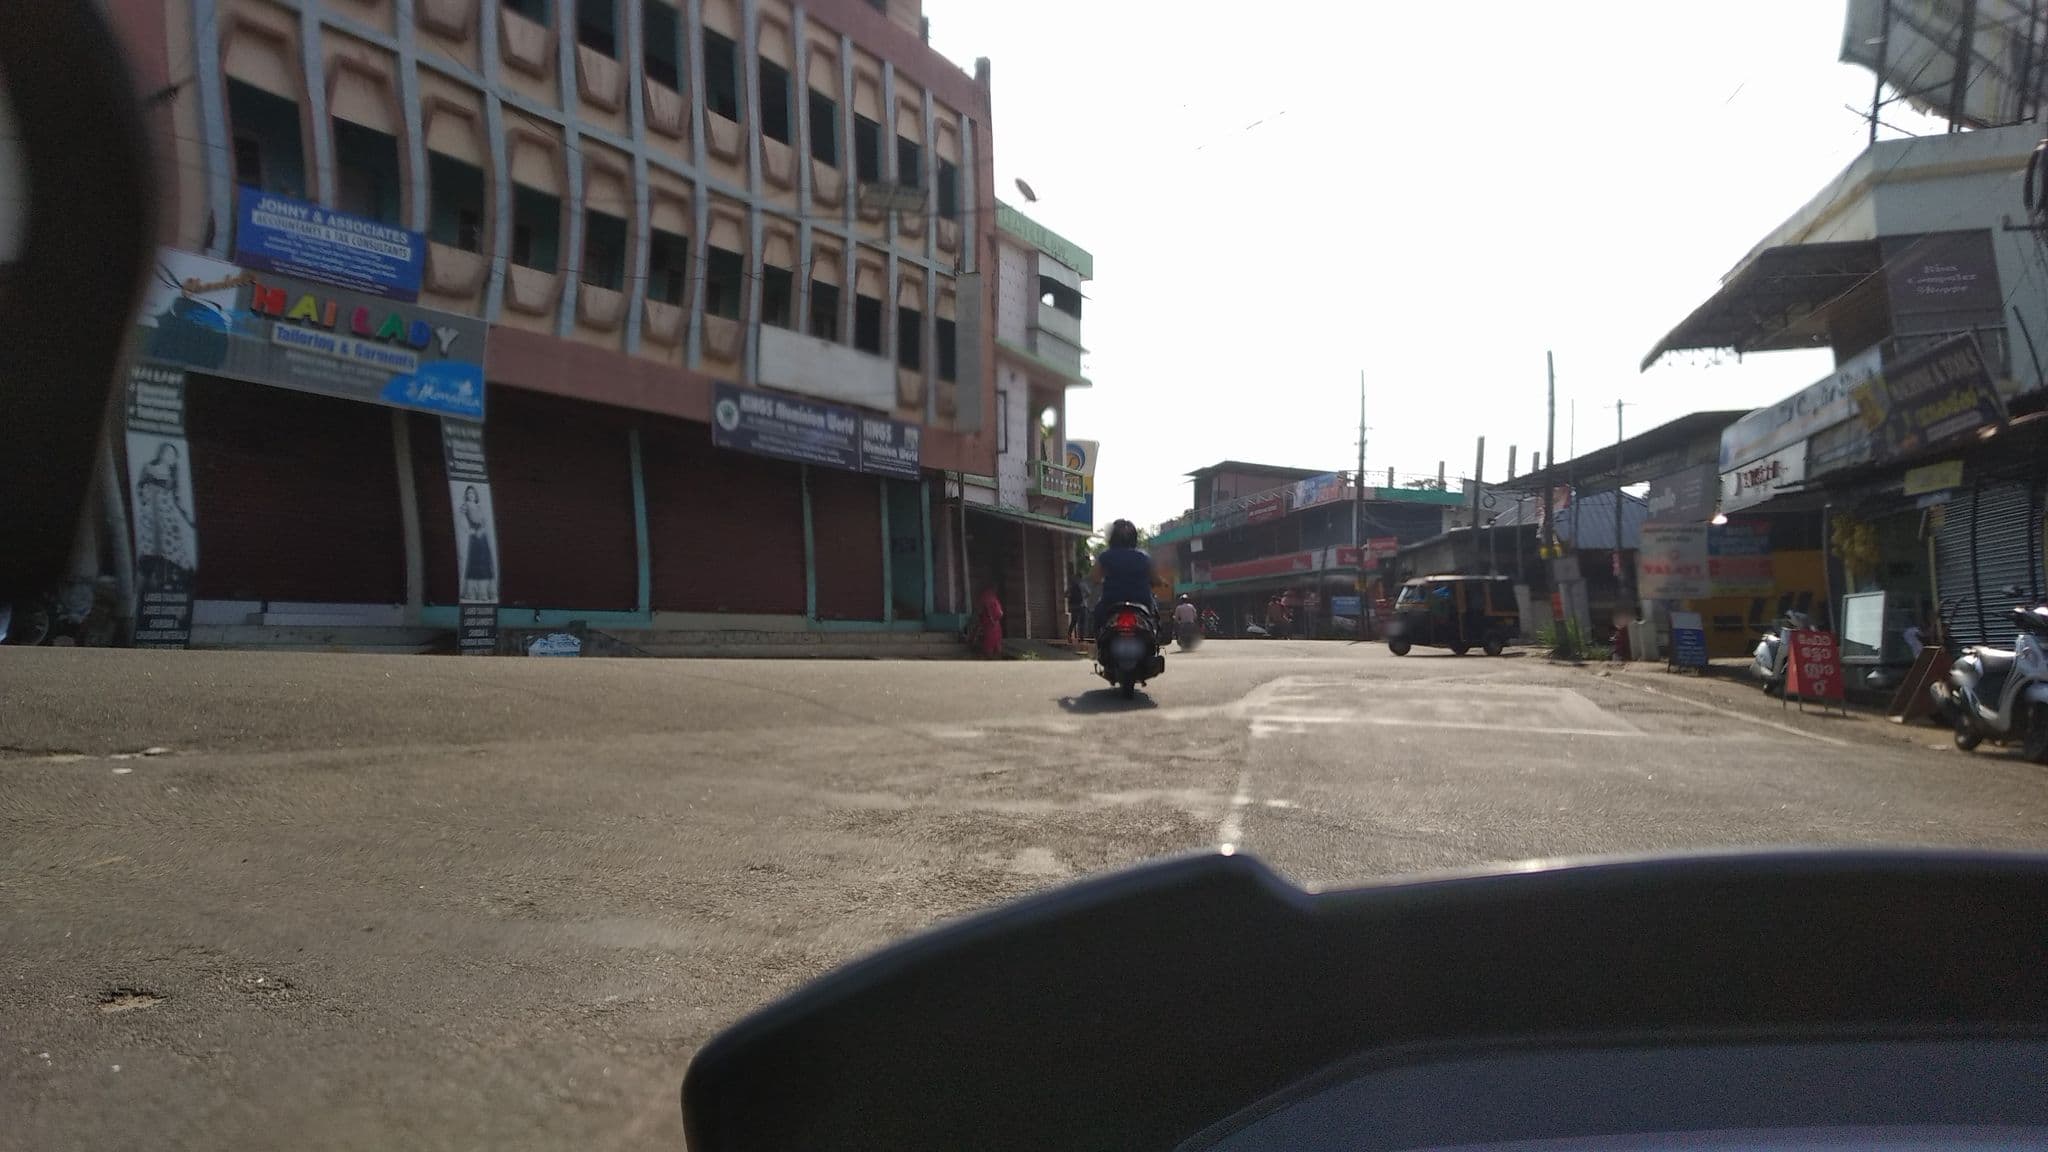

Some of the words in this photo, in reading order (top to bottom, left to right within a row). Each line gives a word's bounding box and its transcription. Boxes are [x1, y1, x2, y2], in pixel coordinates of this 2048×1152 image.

[257, 197, 308, 219] JOHNY
[312, 210, 322, 223] &
[327, 214, 408, 243] ASSOCIATES
[334, 230, 350, 243] TAX
[352, 234, 409, 260] CONSULTANTS
[277, 326, 335, 353] Tailoring
[340, 341, 348, 354] &
[355, 343, 415, 368] Garments
[351, 306, 459, 355] LADY
[740, 394, 773, 417] KINGS
[827, 410, 854, 435] World
